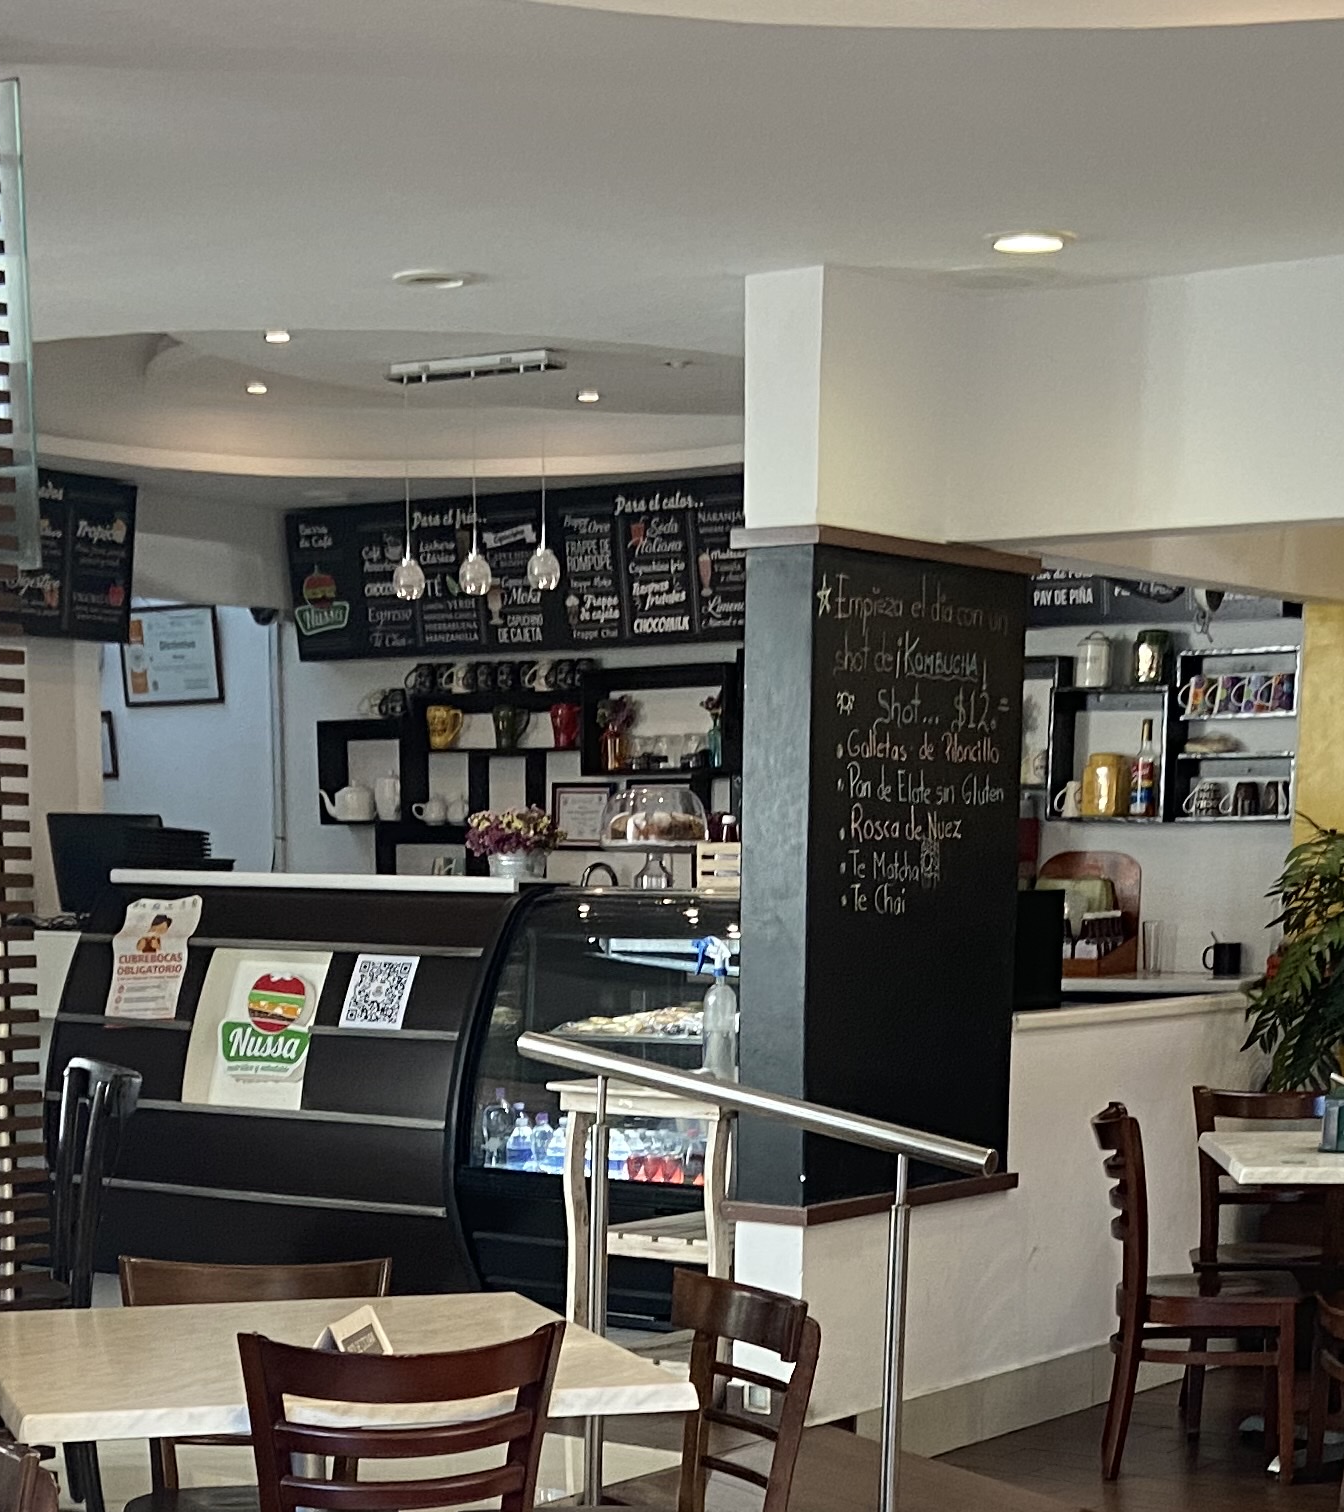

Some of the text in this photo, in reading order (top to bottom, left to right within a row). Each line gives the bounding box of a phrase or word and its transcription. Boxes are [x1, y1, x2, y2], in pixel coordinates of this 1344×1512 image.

[614, 494, 647, 516] Para
[649, 493, 660, 512] el
[411, 511, 441, 530] Para
[442, 509, 454, 525] el
[647, 516, 679, 537] Soda
[698, 511, 745, 523] NARANJA
[312, 535, 333, 549] Café
[911, 574, 926, 617] el
[957, 606, 982, 626] con
[989, 615, 1008, 635] un
[1033, 589, 1053, 607] PAY
[1054, 589, 1067, 605] DE
[1070, 586, 1093, 605] PIÑA
[498, 627, 543, 643] DE CAJETA
[634, 616, 690, 634] CHOCOMILK
[832, 628, 870, 675] shot
[874, 631, 894, 672] de
[847, 729, 907, 762] Galletas
[919, 731, 936, 761] de
[847, 761, 1004, 805] Pan de Elote sin Gluten
[851, 803, 962, 842] Rosca de Nuez
[873, 851, 920, 882] Matcha
[875, 883, 906, 915] Chai
[119, 953, 183, 964] CUBREBOCAS
[117, 964, 183, 976] OBLIGATORIO
[229, 1026, 301, 1060] Nussa
